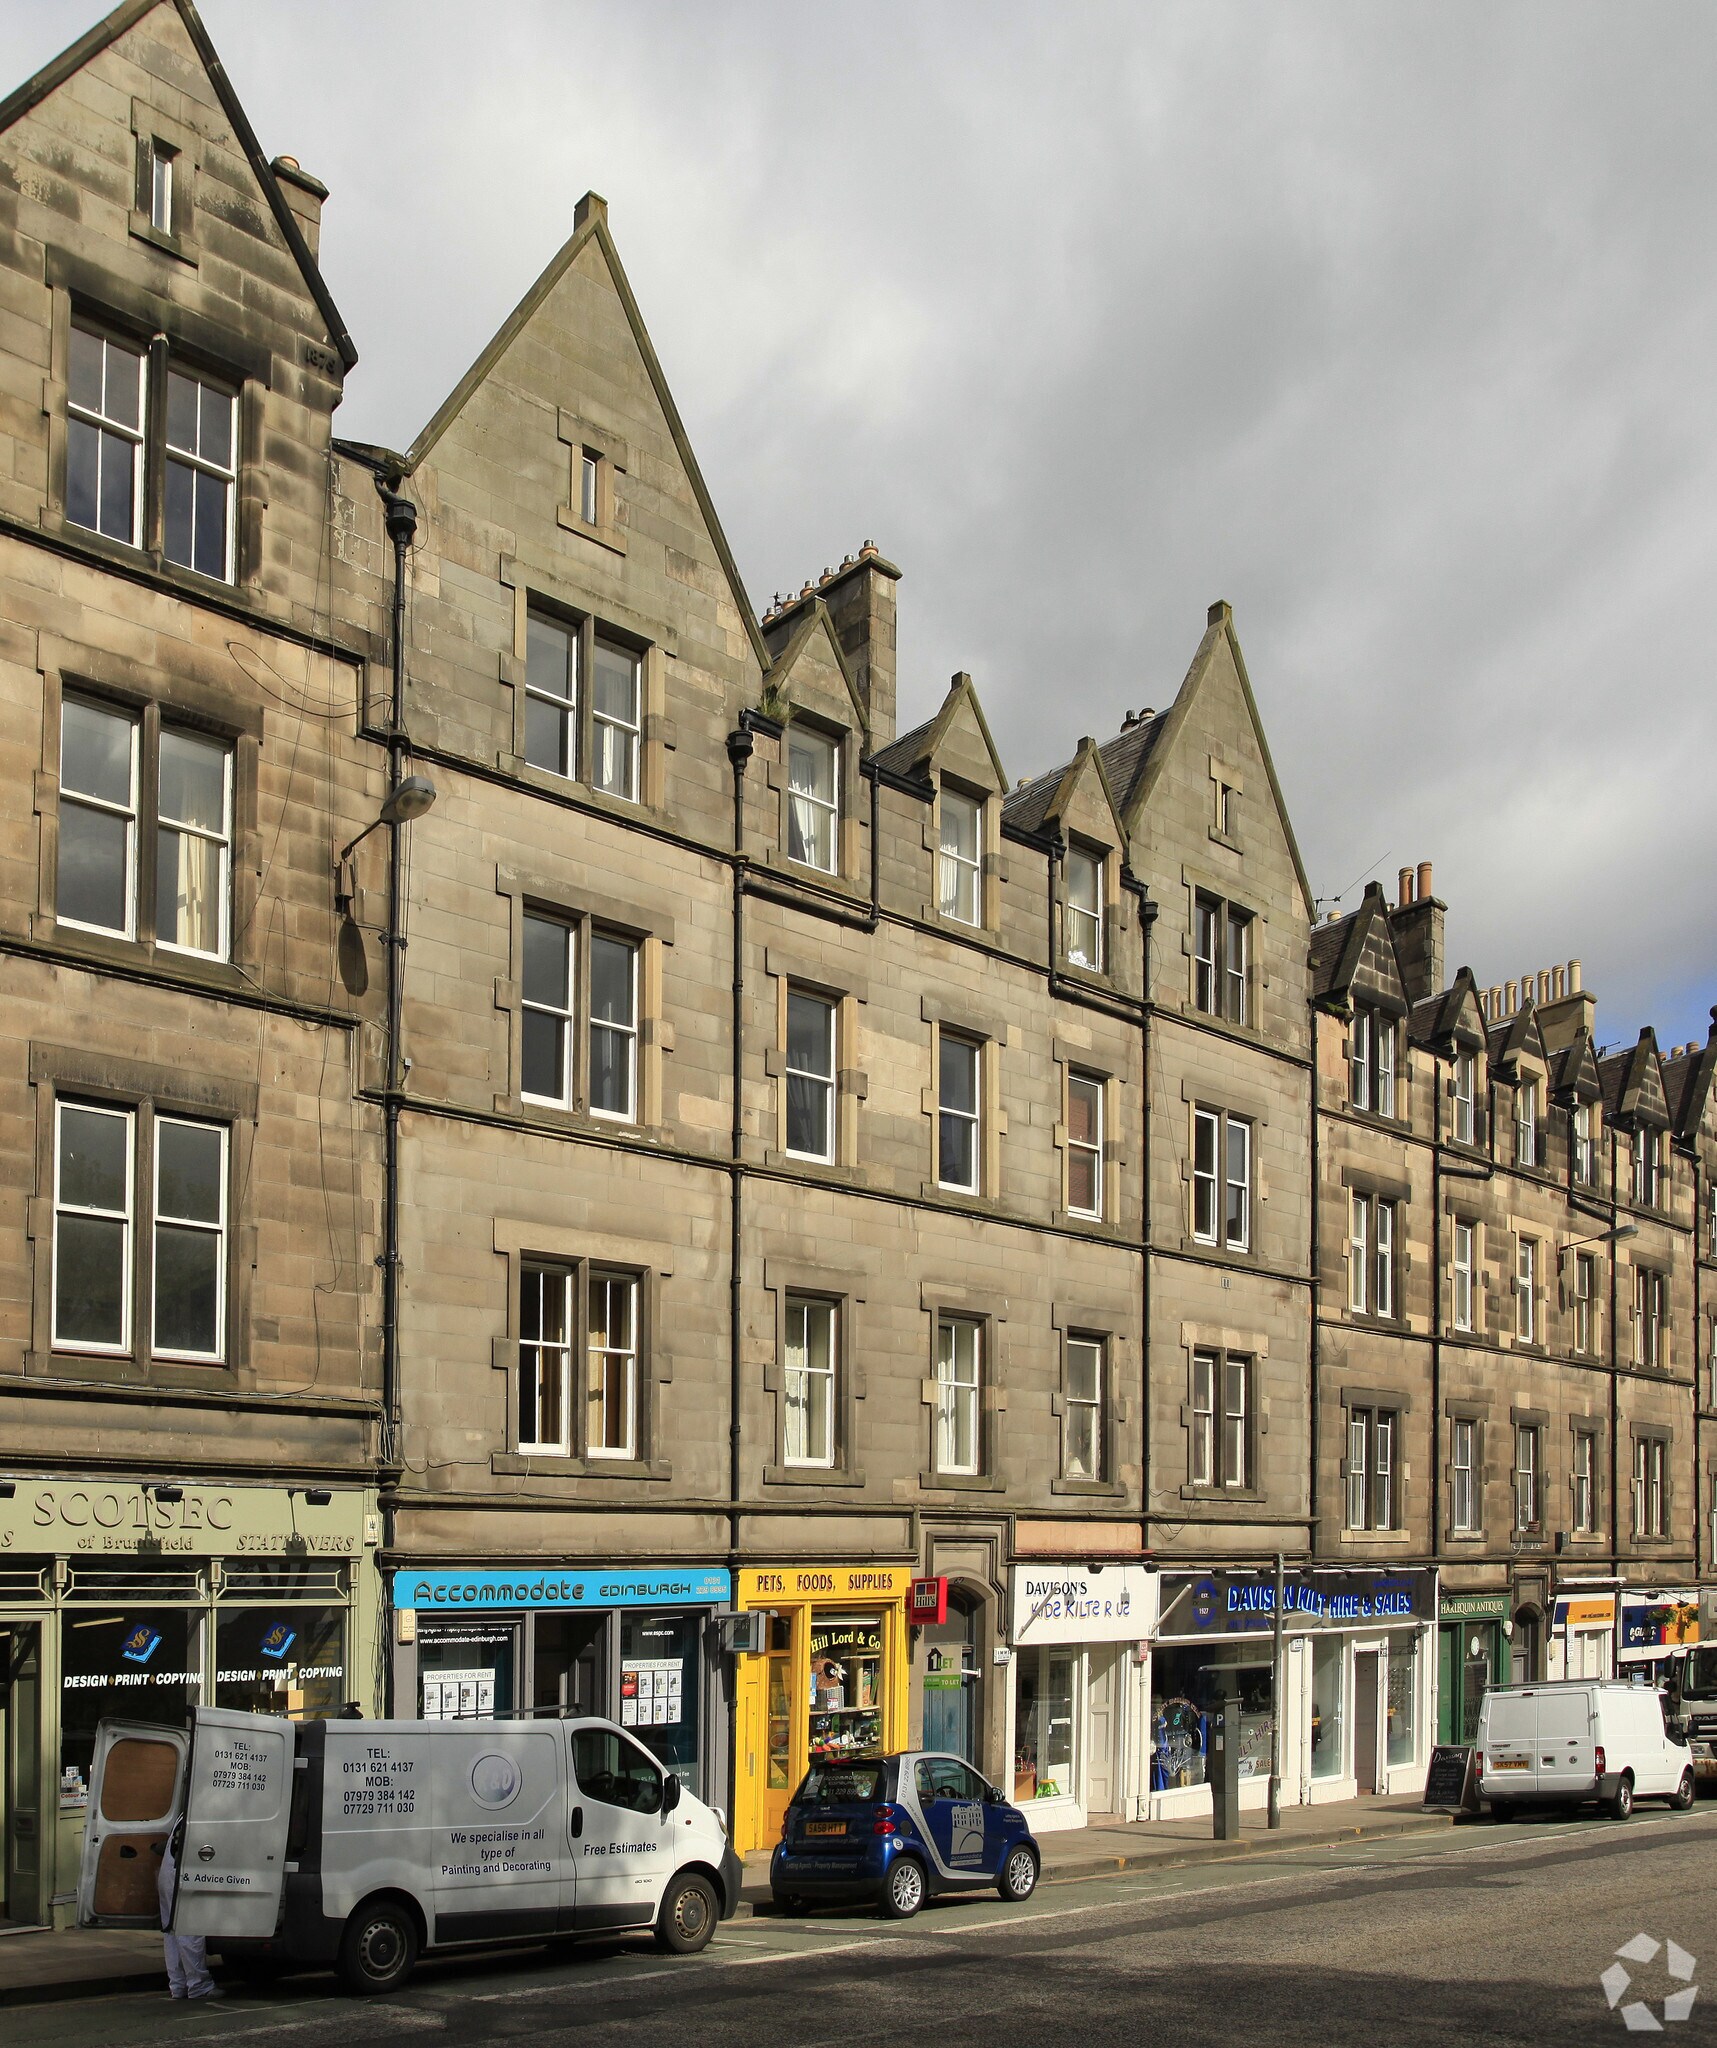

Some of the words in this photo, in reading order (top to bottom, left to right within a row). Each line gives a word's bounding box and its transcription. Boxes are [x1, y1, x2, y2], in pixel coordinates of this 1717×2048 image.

[33, 1491, 233, 1530] SCOTSEC
[77, 1535, 95, 1549] of
[236, 1534, 355, 1551] STATIONERS
[413, 1577, 584, 1602] Accommodate
[600, 1583, 691, 1597] EDINBURGH
[756, 1574, 786, 1593] PETS,
[797, 1574, 836, 1593] FOODS,
[848, 1573, 893, 1590] SUPPLIES
[1026, 1581, 1088, 1595] DAVISON'S
[916, 1596, 935, 1607] Hill's
[1297, 1586, 1327, 1618] KILT
[1329, 1593, 1359, 1619] HIRE
[1362, 1593, 1372, 1617] &
[1374, 1590, 1412, 1616] SALES
[1441, 1602, 1475, 1616] HARLEQUIN
[1476, 1601, 1504, 1613] ANTIQUES
[1065, 1600, 1100, 1618] KILTS
[1104, 1600, 1112, 1617] R
[1117, 1600, 1130, 1617] US
[811, 1636, 829, 1653] Hill
[831, 1631, 854, 1644] Lord
[857, 1631, 865, 1645] &
[868, 1634, 881, 1650] Co
[64, 1675, 108, 1688] DESIGN
[114, 1673, 150, 1686] PRINT
[155, 1672, 205, 1685] COPYING
[217, 1670, 256, 1682] DESIGN
[262, 1668, 293, 1680] PRINT
[299, 1666, 343, 1679] COPYING
[1216, 1714, 1224, 1725] P
[234, 1742, 251, 1751] TEL:
[367, 1748, 390, 1758] TEL:
[215, 1750, 232, 1759] 0131
[235, 1753, 248, 1761] 621
[250, 1754, 267, 1762] 4137
[230, 1762, 251, 1771] MOB:
[343, 1763, 367, 1773] 0131
[370, 1762, 387, 1772] 621
[391, 1762, 414, 1772] 4137
[213, 1770, 236, 1780] 07979
[238, 1773, 251, 1781] 384
[254, 1774, 266, 1782] 142
[365, 1776, 393, 1787] MOB:
[212, 1780, 235, 1788] 07729
[251, 1782, 265, 1791] 030
[344, 1791, 374, 1801] 07979
[377, 1790, 395, 1800] 384
[398, 1790, 415, 1800] 142
[343, 1804, 374, 1814] 07729
[377, 1803, 393, 1813] 711
[397, 1802, 414, 1813] 030
[451, 1832, 467, 1844] We
[469, 1830, 518, 1846] specialise
[521, 1830, 531, 1841] in
[533, 1828, 544, 1840] all
[480, 1848, 503, 1861] type
[505, 1846, 515, 1858] of
[583, 1844, 606, 1856] Free
[609, 1841, 657, 1854] Estimates
[441, 1864, 481, 1876] Painting
[483, 1862, 500, 1873] and
[502, 1860, 551, 1872] Decorating
[182, 1873, 189, 1881] &
[194, 1874, 224, 1884] Advice
[226, 1875, 251, 1885] Given
